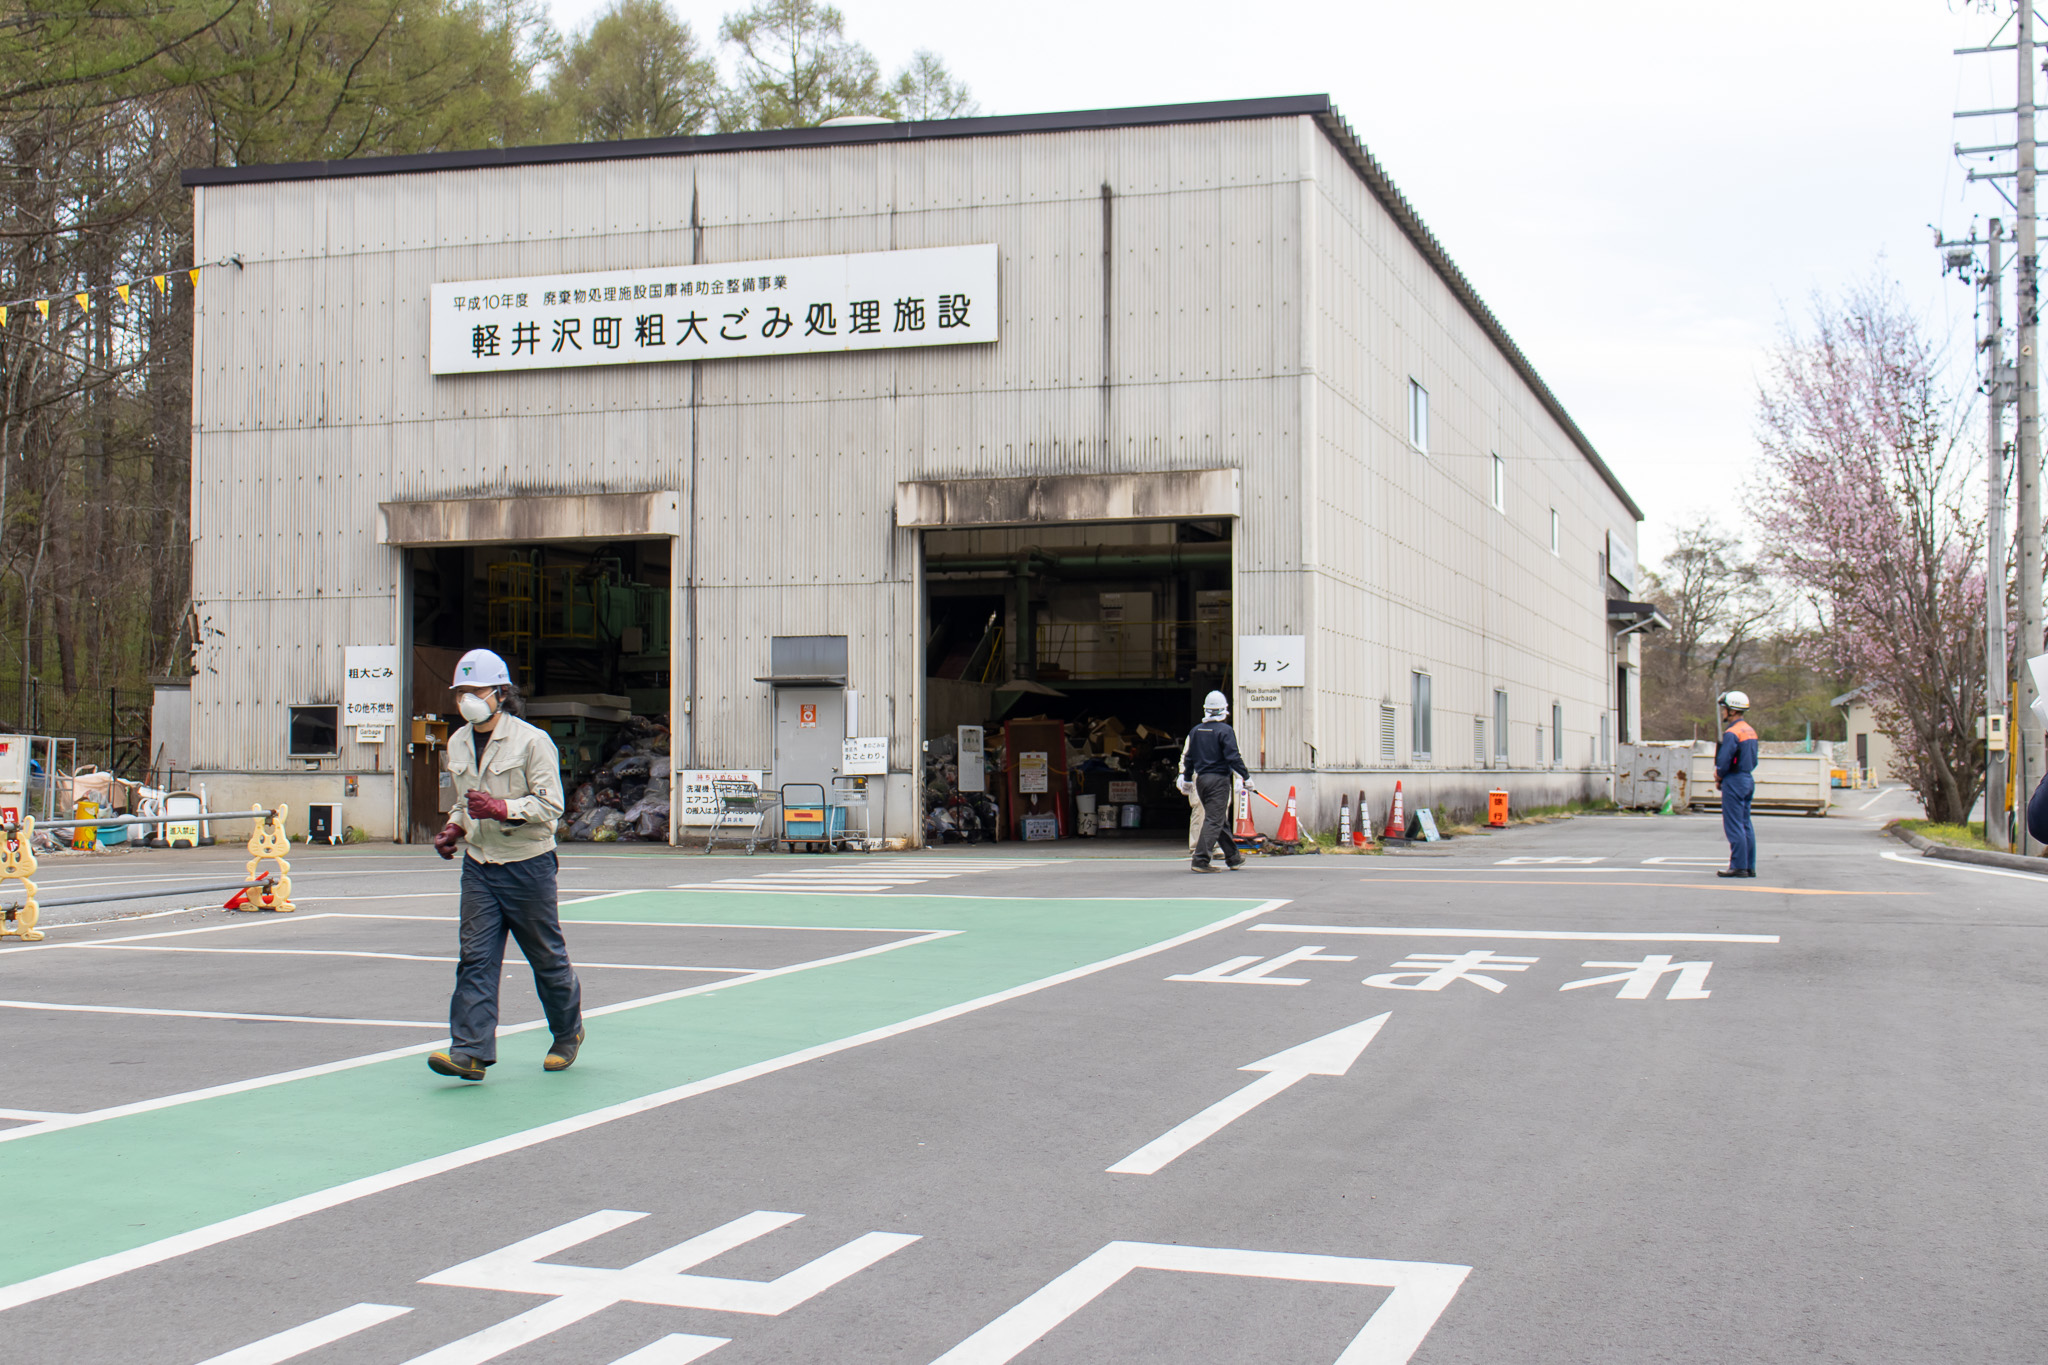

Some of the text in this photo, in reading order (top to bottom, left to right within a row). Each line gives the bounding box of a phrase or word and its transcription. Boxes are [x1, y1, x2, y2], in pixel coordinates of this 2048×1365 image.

[453, 274, 789, 312] 平成10年度 廃棄物処理施設国庫補助金整備事業
[471, 294, 972, 360] 軽井沢町粗大ごみ処理施設
[1253, 660, 1290, 672] カン
[348, 667, 394, 679] 粗大ごみ
[346, 702, 394, 714] その他不燃物
[169, 826, 196, 836] 進入禁止
